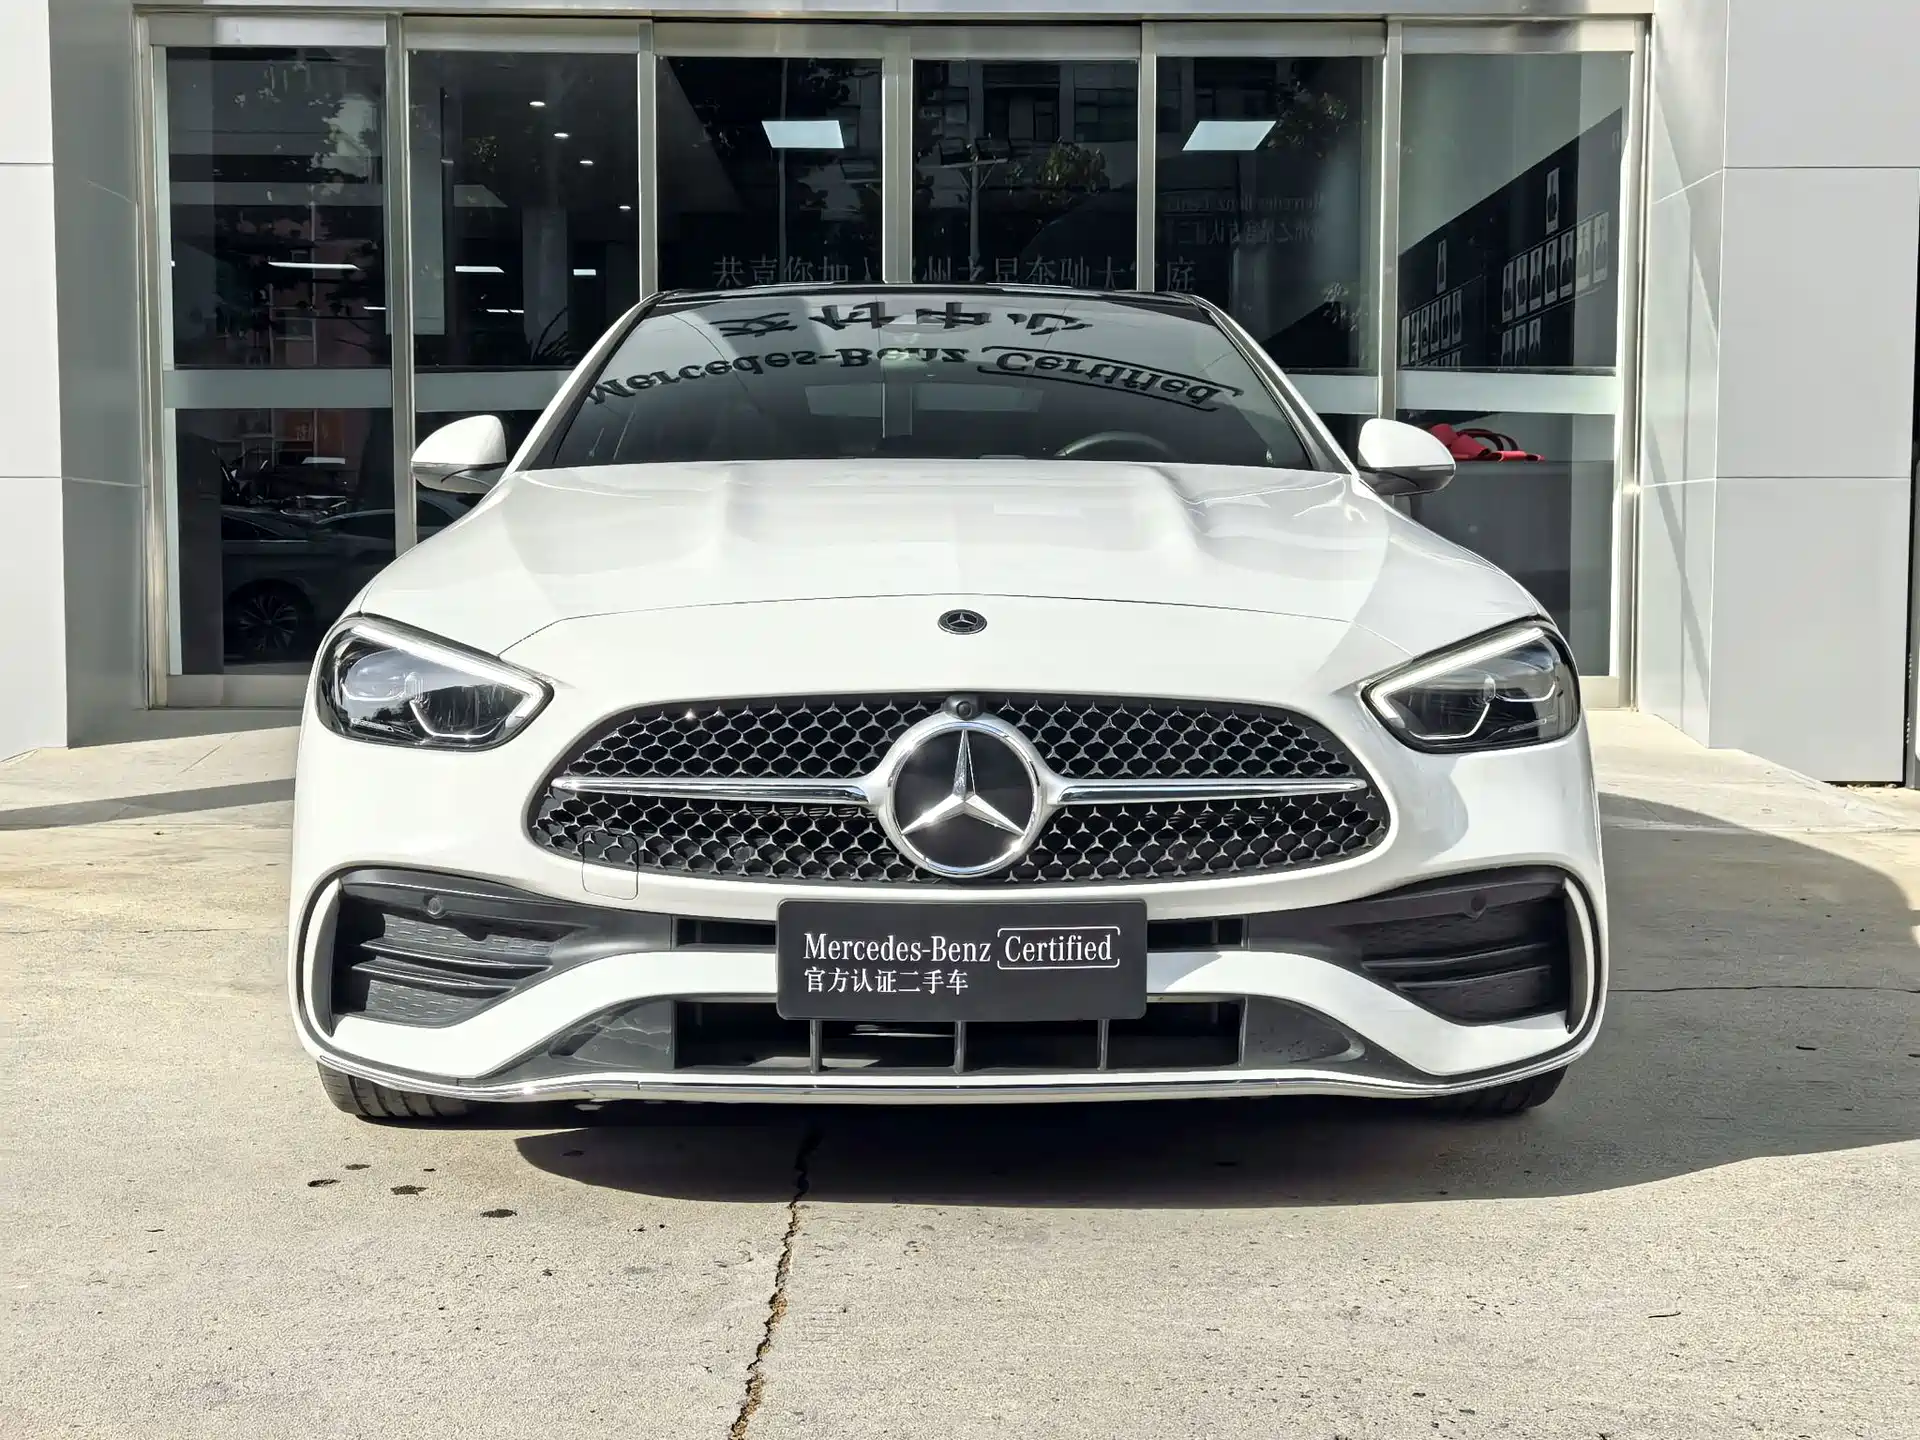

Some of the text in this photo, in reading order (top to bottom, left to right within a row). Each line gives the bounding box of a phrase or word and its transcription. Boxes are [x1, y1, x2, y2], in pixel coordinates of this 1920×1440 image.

[803, 932, 1113, 964] Mercedes-Benz Certified
[803, 966, 970, 995] 官方认证二手车
